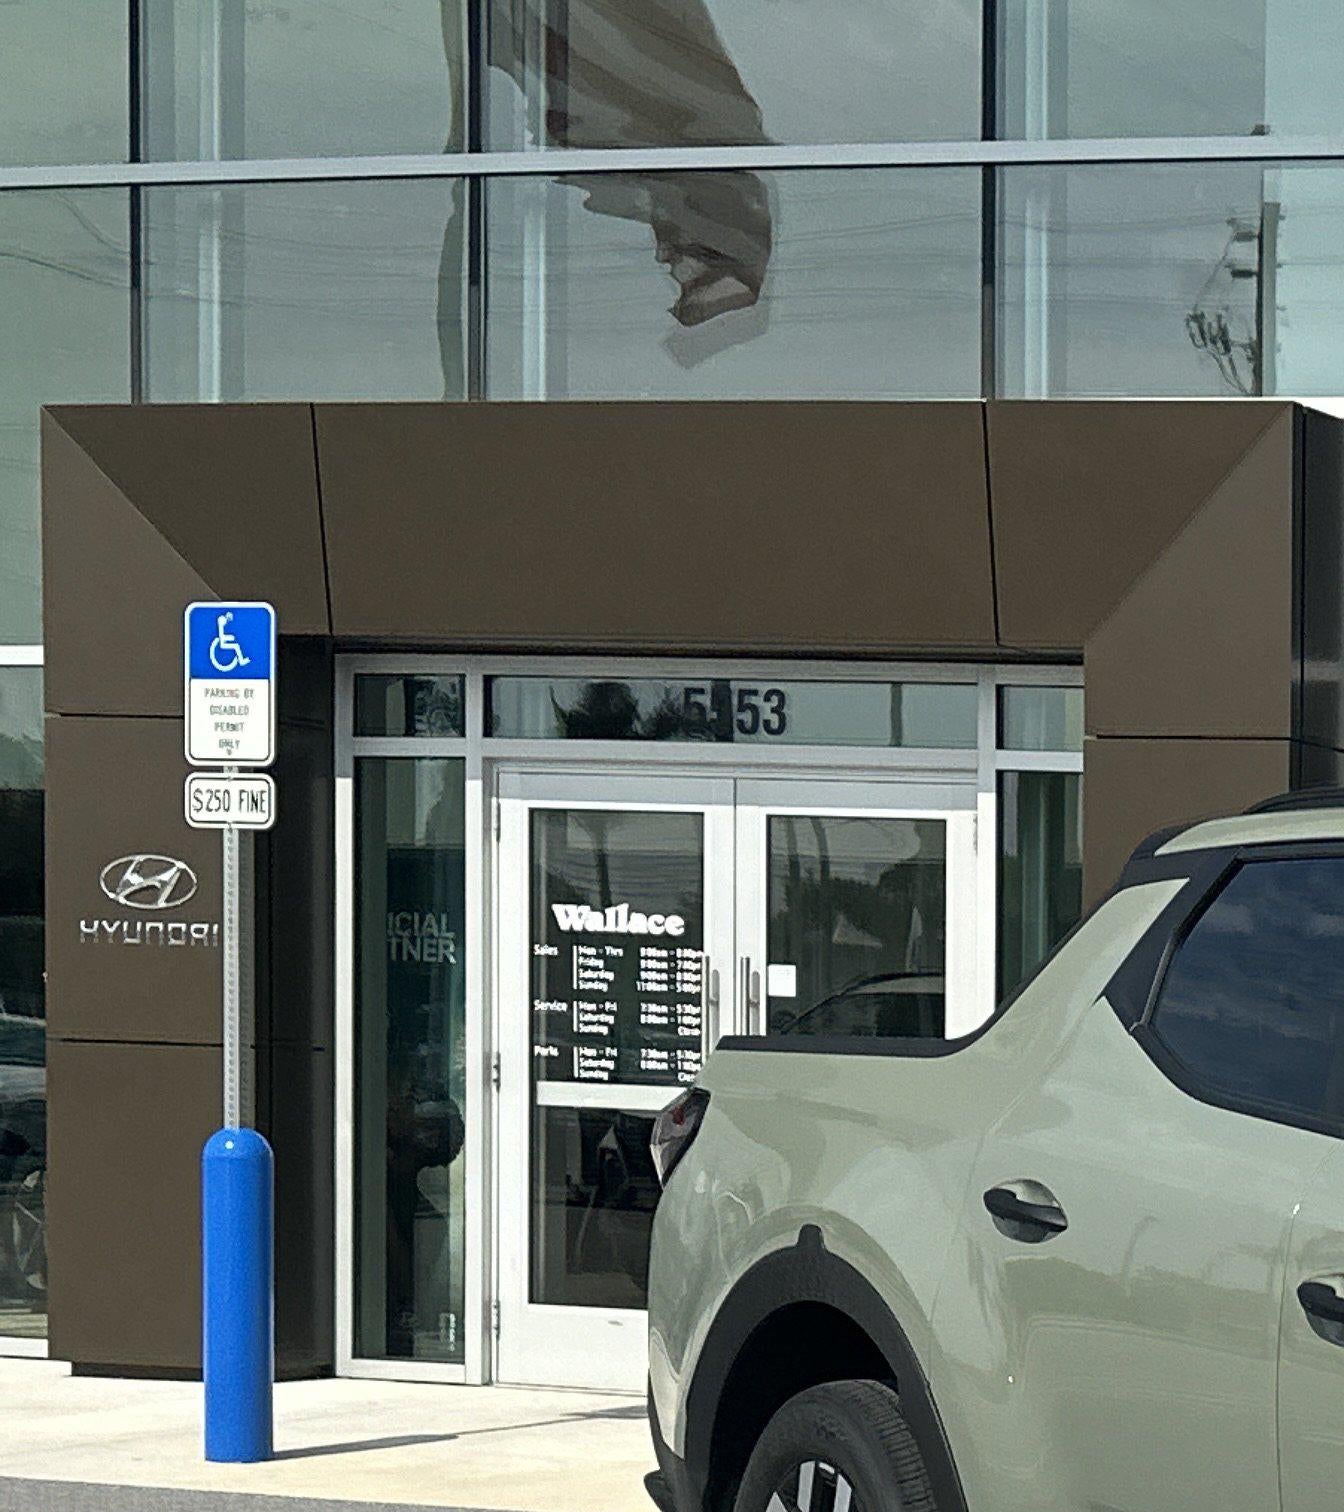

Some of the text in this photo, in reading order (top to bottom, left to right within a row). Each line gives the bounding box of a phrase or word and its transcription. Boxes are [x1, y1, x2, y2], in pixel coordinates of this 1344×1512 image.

[684, 687, 787, 735] 553
[192, 787, 268, 814] $250 FINE
[79, 919, 219, 947] HYUNDAI
[387, 911, 456, 937] ICIAL
[551, 902, 686, 937] Wallace
[385, 937, 457, 965] TNER
[533, 1000, 568, 1012] Service
